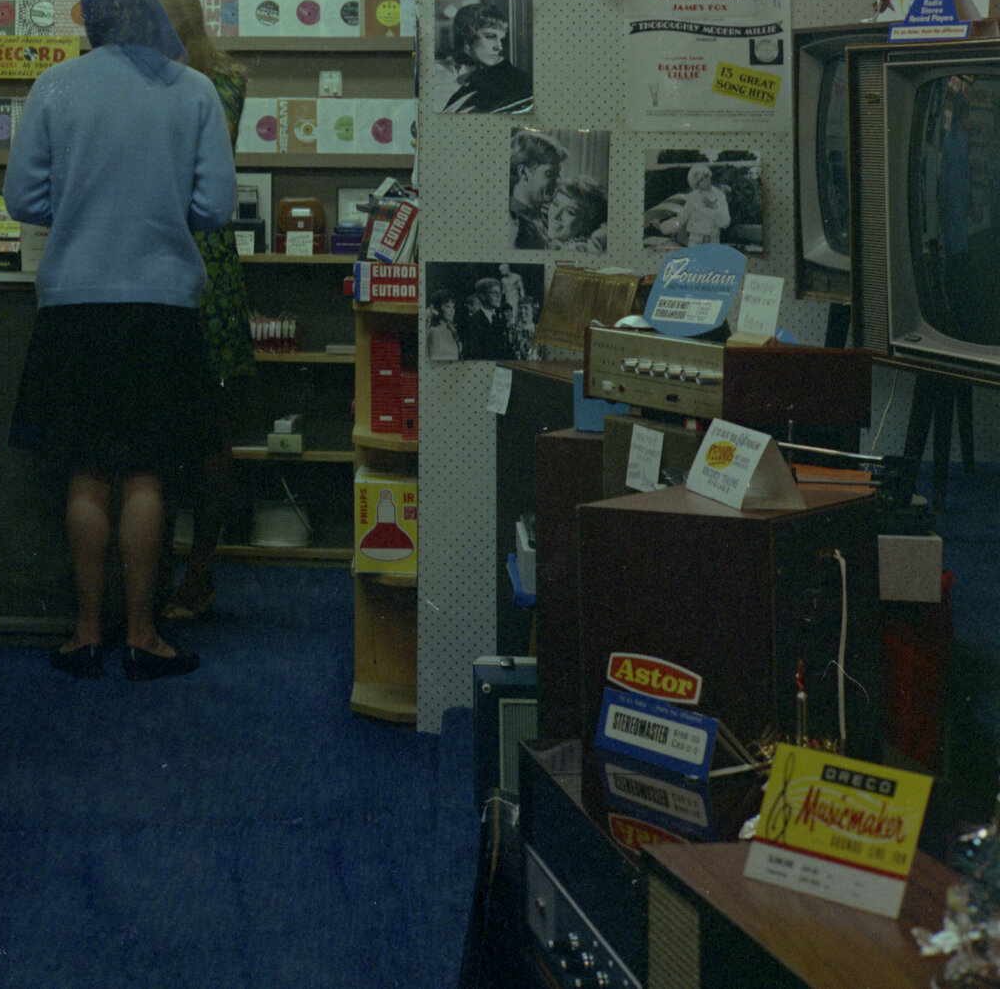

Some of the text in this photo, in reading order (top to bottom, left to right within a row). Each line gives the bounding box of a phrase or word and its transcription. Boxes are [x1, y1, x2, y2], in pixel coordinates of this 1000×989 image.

[708, 3, 728, 11] FOX
[702, 26, 741, 36] MODERN
[716, 79, 747, 95] SONG
[738, 73, 776, 91] GREAT
[384, 203, 413, 248] EUTRON
[372, 265, 416, 279] EUTRON
[661, 257, 736, 289] Fountain
[371, 284, 416, 297] EUTRON
[359, 487, 368, 525] PHILIPS
[613, 658, 694, 697] Astor
[612, 711, 670, 745] STEREOMASTER
[793, 785, 907, 843] Musicmaker
